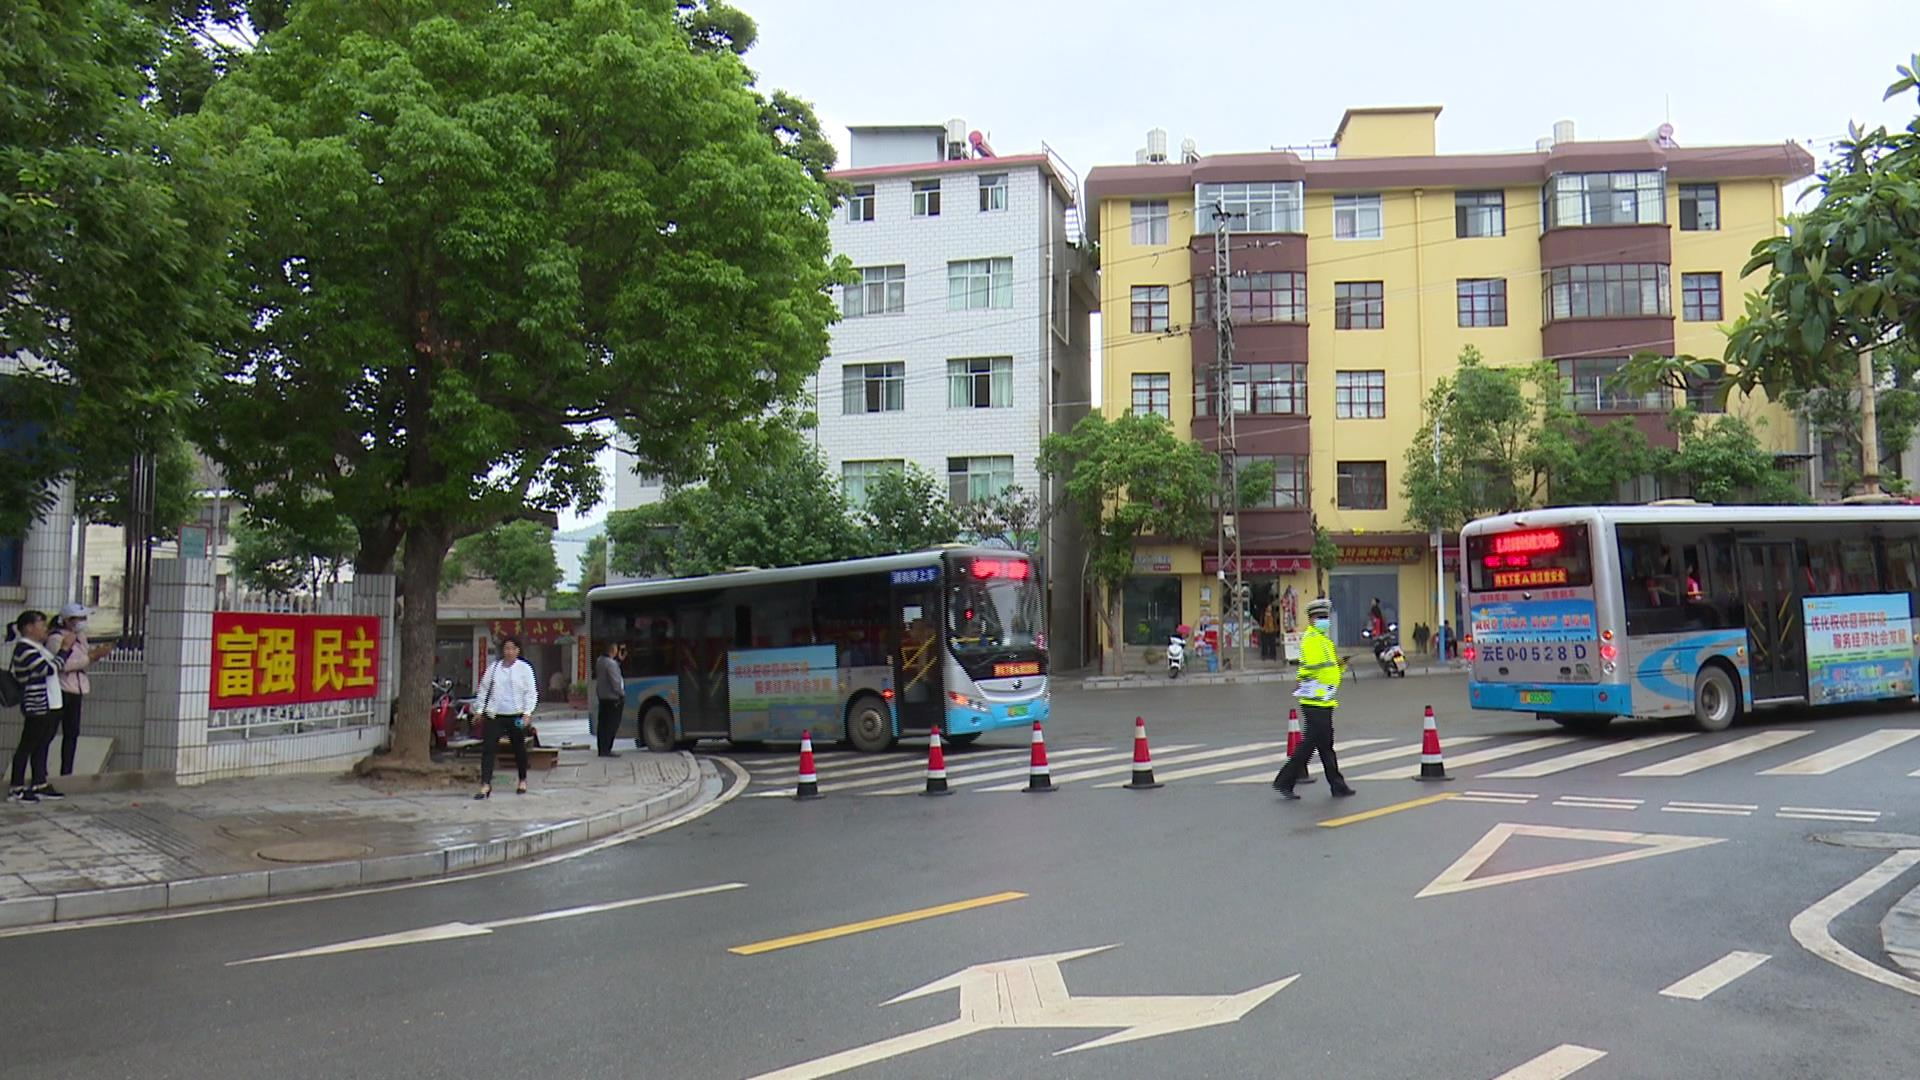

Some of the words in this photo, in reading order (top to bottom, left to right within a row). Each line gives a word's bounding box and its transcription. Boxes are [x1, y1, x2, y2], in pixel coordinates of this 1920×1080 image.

[1811, 611, 1887, 632] 优化税收营商环境
[1832, 629, 1906, 648] 服务经济社会发展
[217, 625, 295, 698] 富强
[312, 626, 375, 692] 民主
